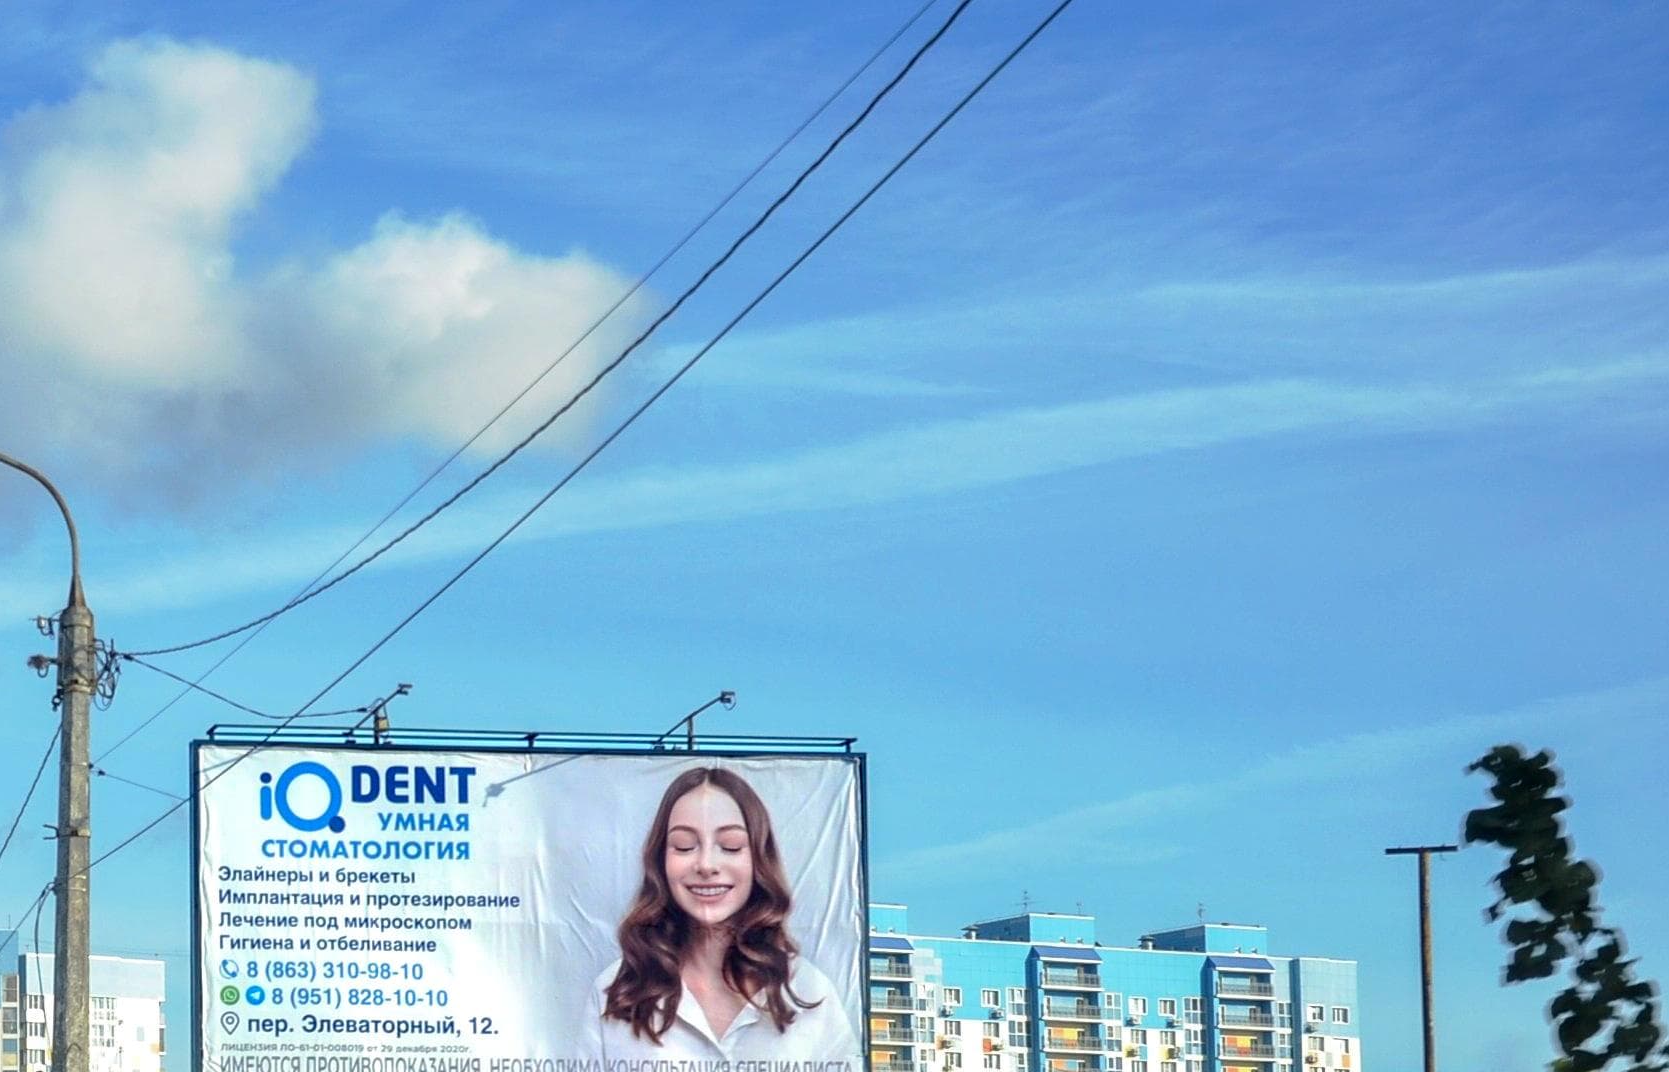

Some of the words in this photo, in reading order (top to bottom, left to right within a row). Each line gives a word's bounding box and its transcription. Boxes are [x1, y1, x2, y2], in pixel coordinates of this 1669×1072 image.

[259, 761, 346, 833] iQ
[351, 765, 476, 804] DENT
[377, 812, 470, 832] УМНАЯ
[261, 839, 470, 860] СТОМАТОЛОГИЯ
[218, 866, 313, 884] Элайнеры
[319, 870, 329, 882] и
[335, 867, 415, 887] брекеты
[218, 889, 344, 909] Имплантация
[350, 894, 360, 906] и
[367, 894, 520, 911] протезирование
[218, 912, 298, 928] Лечение
[304, 916, 339, 930] под
[344, 916, 472, 932] микроскопом
[219, 934, 294, 950] Гигиена
[300, 938, 310, 950] и
[316, 936, 437, 952] отбеливание
[246, 962, 258, 978] 8
[265, 961, 316, 981] (863)
[323, 962, 423, 980] 310-98-10
[271, 988, 283, 1005] 8
[290, 988, 341, 1008] (951)
[348, 988, 448, 1006] 828-10-10
[247, 1018, 294, 1037] пер.
[301, 1014, 461, 1038] Элеваторный,
[468, 1017, 499, 1034] 12.
[221, 1043, 277, 1052] ЛИЦЕНЗИЯ
[381, 1045, 393, 1053] 29
[395, 1045, 437, 1054] декабря
